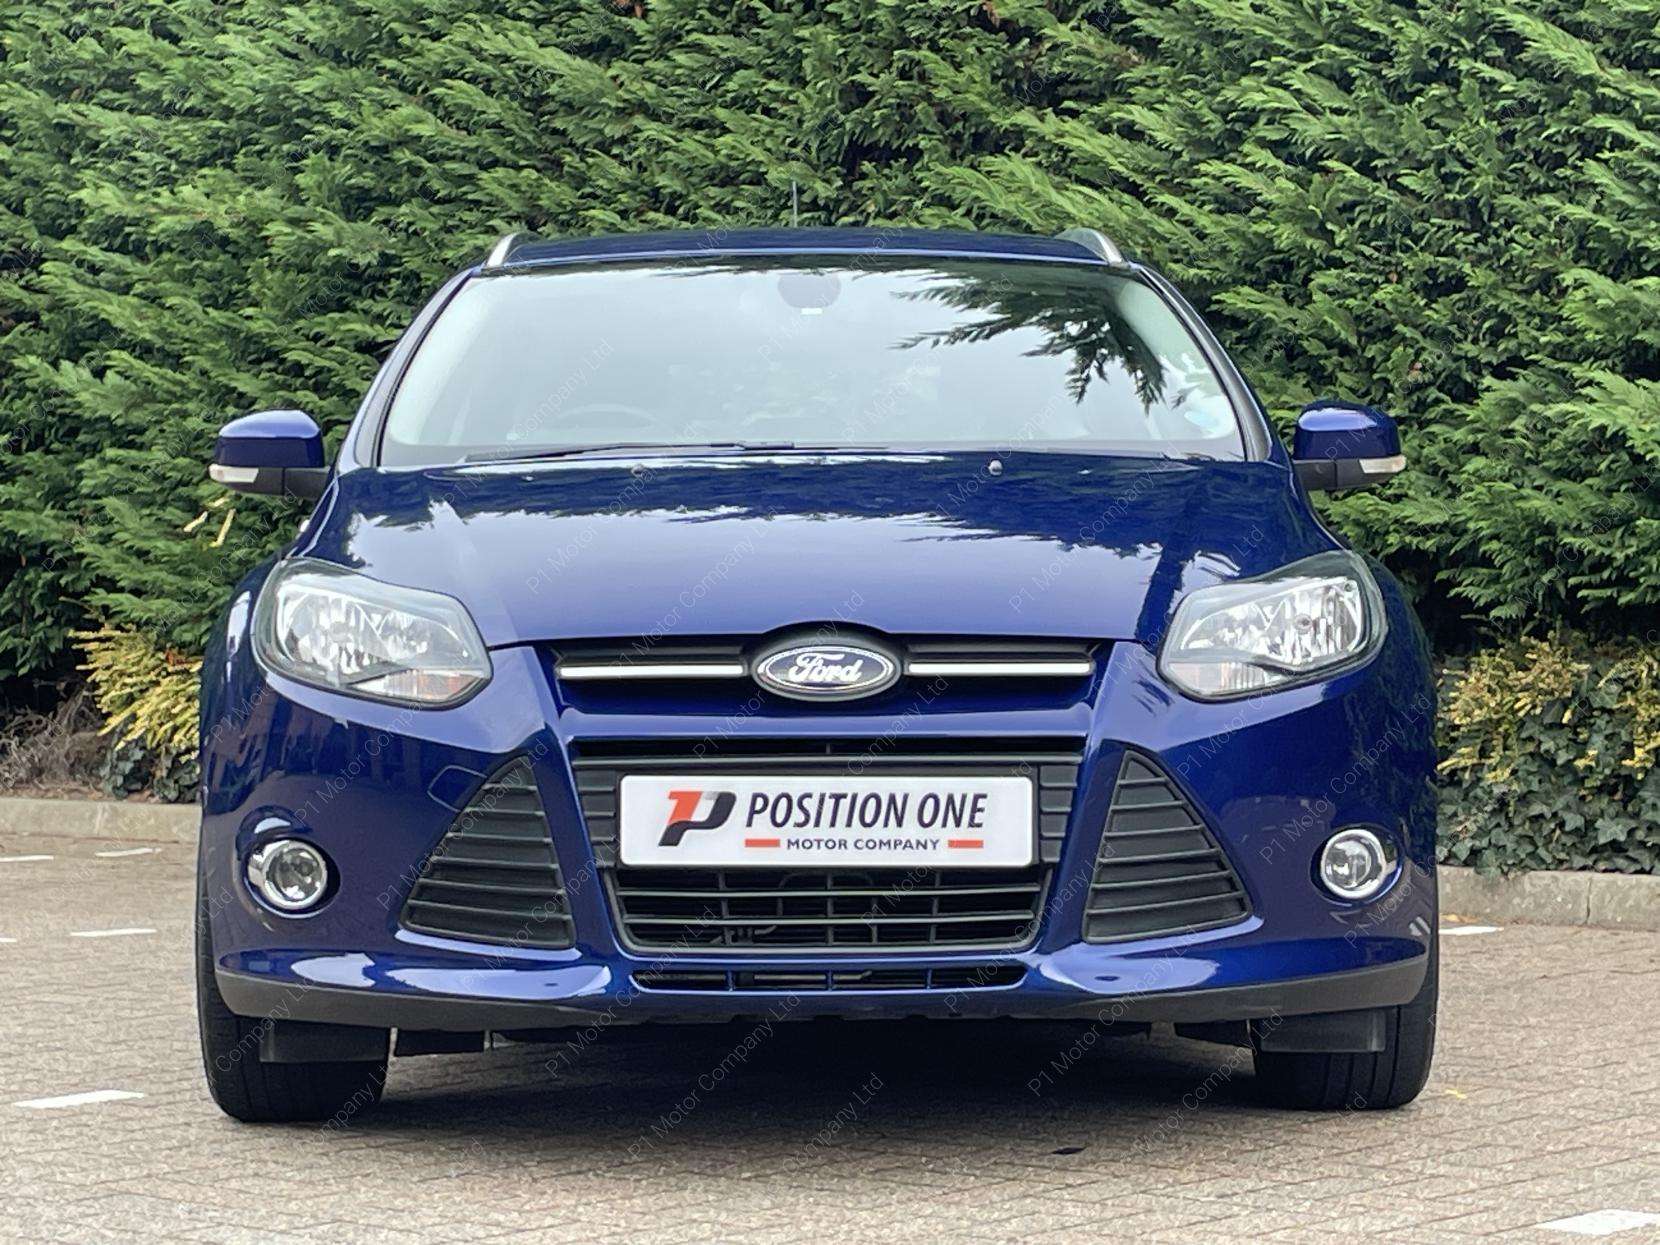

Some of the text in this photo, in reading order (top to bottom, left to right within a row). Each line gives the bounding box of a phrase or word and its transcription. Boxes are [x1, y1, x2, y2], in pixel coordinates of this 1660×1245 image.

[788, 653, 863, 682] Ford
[746, 793, 987, 828] POSITION ONE
[788, 839, 939, 849] MOTOR COMPANY
